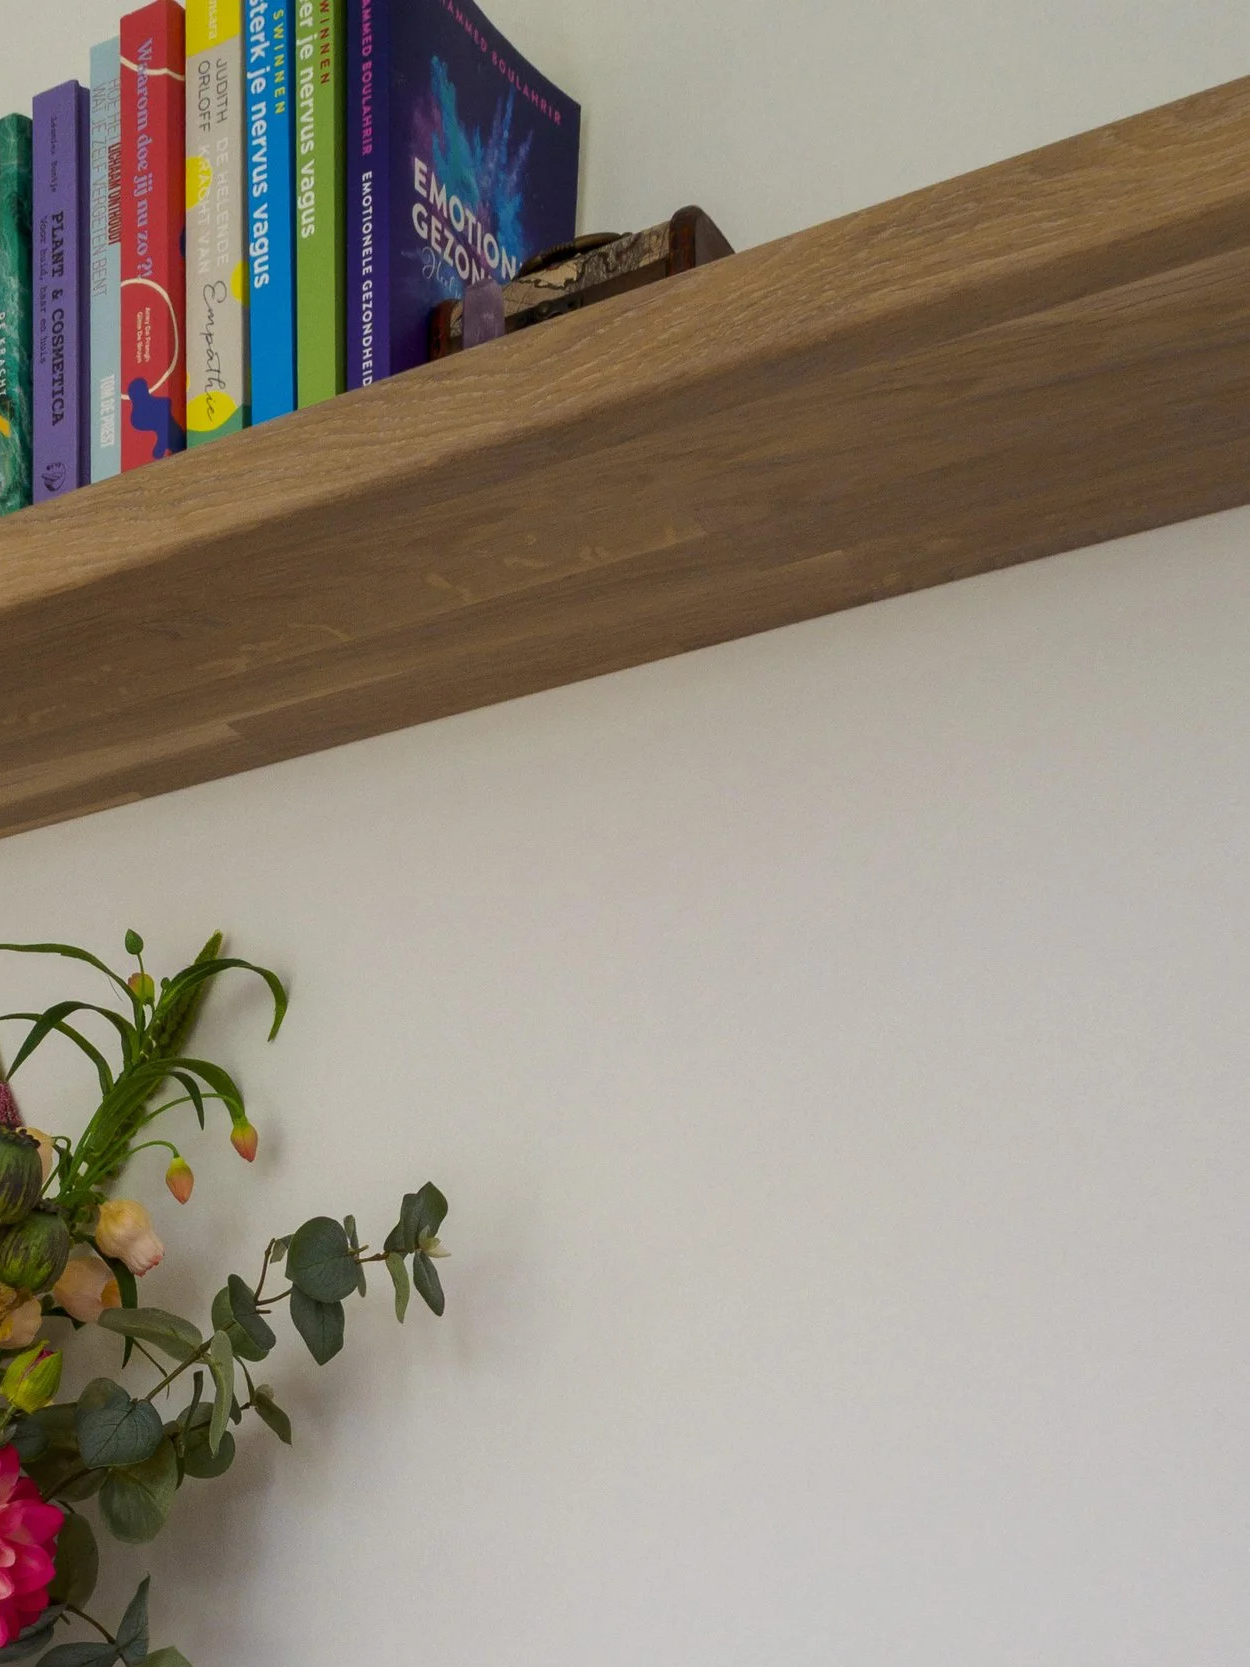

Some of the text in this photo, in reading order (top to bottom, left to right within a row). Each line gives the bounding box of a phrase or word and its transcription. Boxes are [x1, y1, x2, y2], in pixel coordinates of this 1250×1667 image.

[106, 77, 121, 112] HOE
[136, 37, 153, 131] Waarom
[197, 59, 211, 133] ORLOFF
[215, 58, 228, 124] JUDITH
[246, 65, 272, 95] je
[272, 9, 286, 115] SWINNEN
[441, 0, 562, 126] AMMED BOULAHRIR
[107, 113, 121, 143] HET
[250, 101, 269, 198] nervus
[295, 0, 318, 239] er je nervus vagus
[361, 59, 373, 156] BOULAHRIR
[91, 81, 108, 298] WAT JE ZELF VERGETEN BENT
[133, 171, 154, 197] jij
[136, 133, 153, 172] doe
[39, 215, 49, 245] Voor
[136, 198, 149, 228] nu
[136, 230, 149, 257] zo
[197, 144, 211, 276] KRACHT VAN
[215, 136, 230, 268] DE HELENDE
[411, 202, 493, 287] GEZON
[414, 156, 523, 281] EMOTION
[248, 202, 271, 289] vagus
[362, 170, 373, 388] EMOTIONELE GEZONDHEID
[39, 286, 49, 313] haar
[39, 318, 47, 334] en
[50, 210, 65, 427] PLANT & COSMETICA
[39, 336, 49, 365] huis
[199, 280, 228, 423] Empathie
[100, 374, 115, 449] TOM DE PREST
